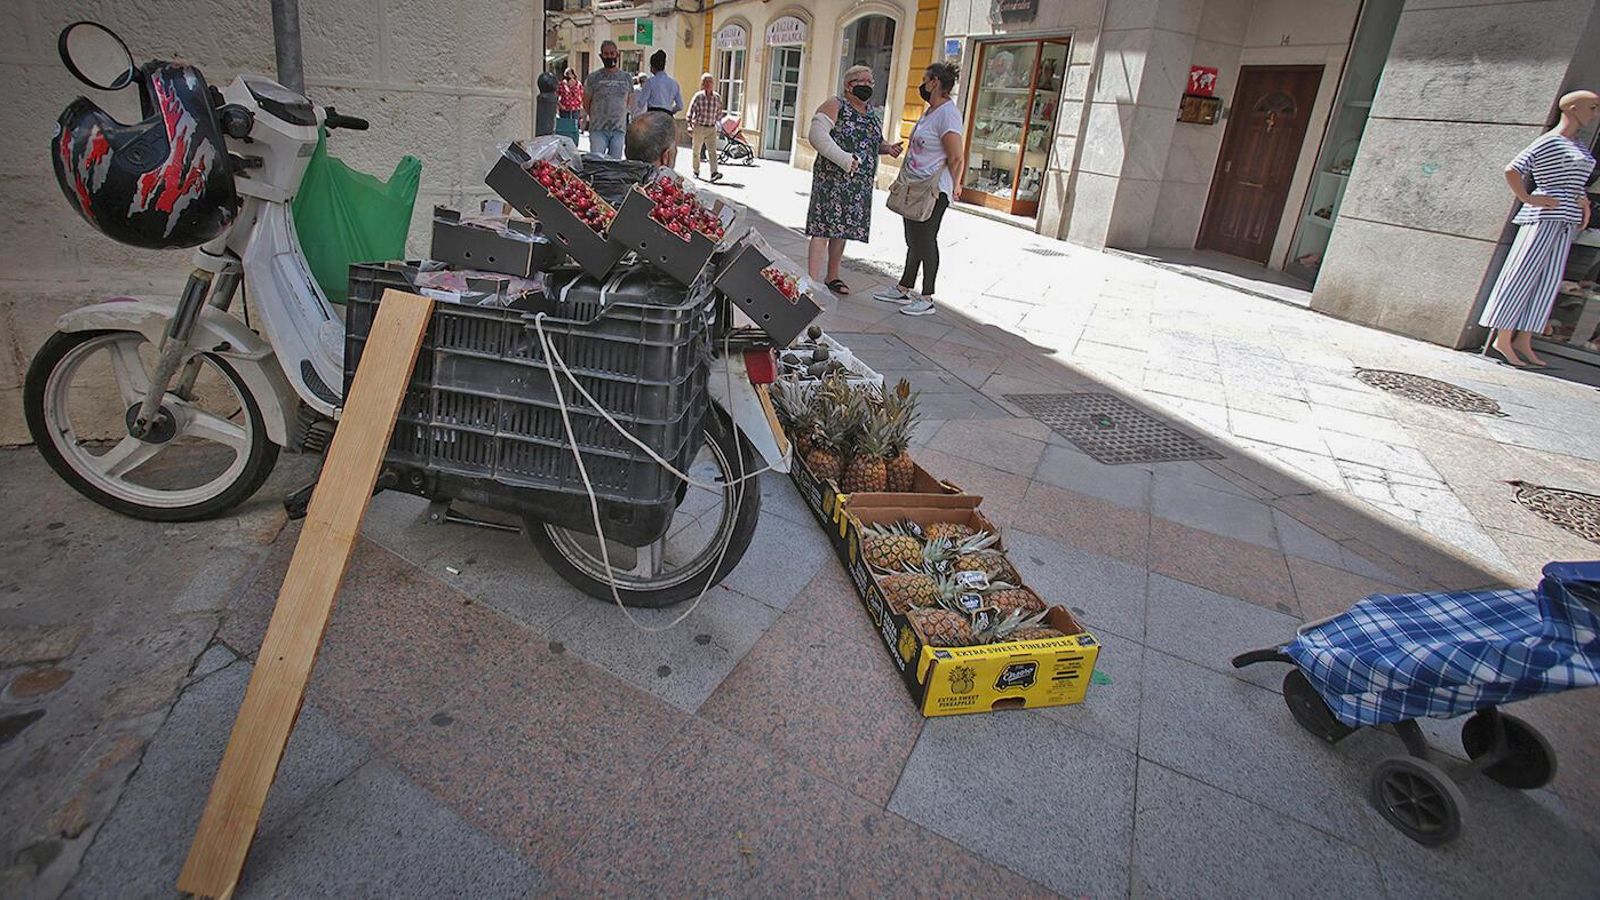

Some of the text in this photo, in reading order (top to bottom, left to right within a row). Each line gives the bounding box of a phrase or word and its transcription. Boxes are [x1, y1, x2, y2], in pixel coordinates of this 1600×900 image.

[956, 649, 987, 657] EXTRA
[987, 645, 1018, 654] SWEET
[1020, 639, 1074, 650] PINEAPPLES
[939, 700, 976, 708] PINEAPPLES
